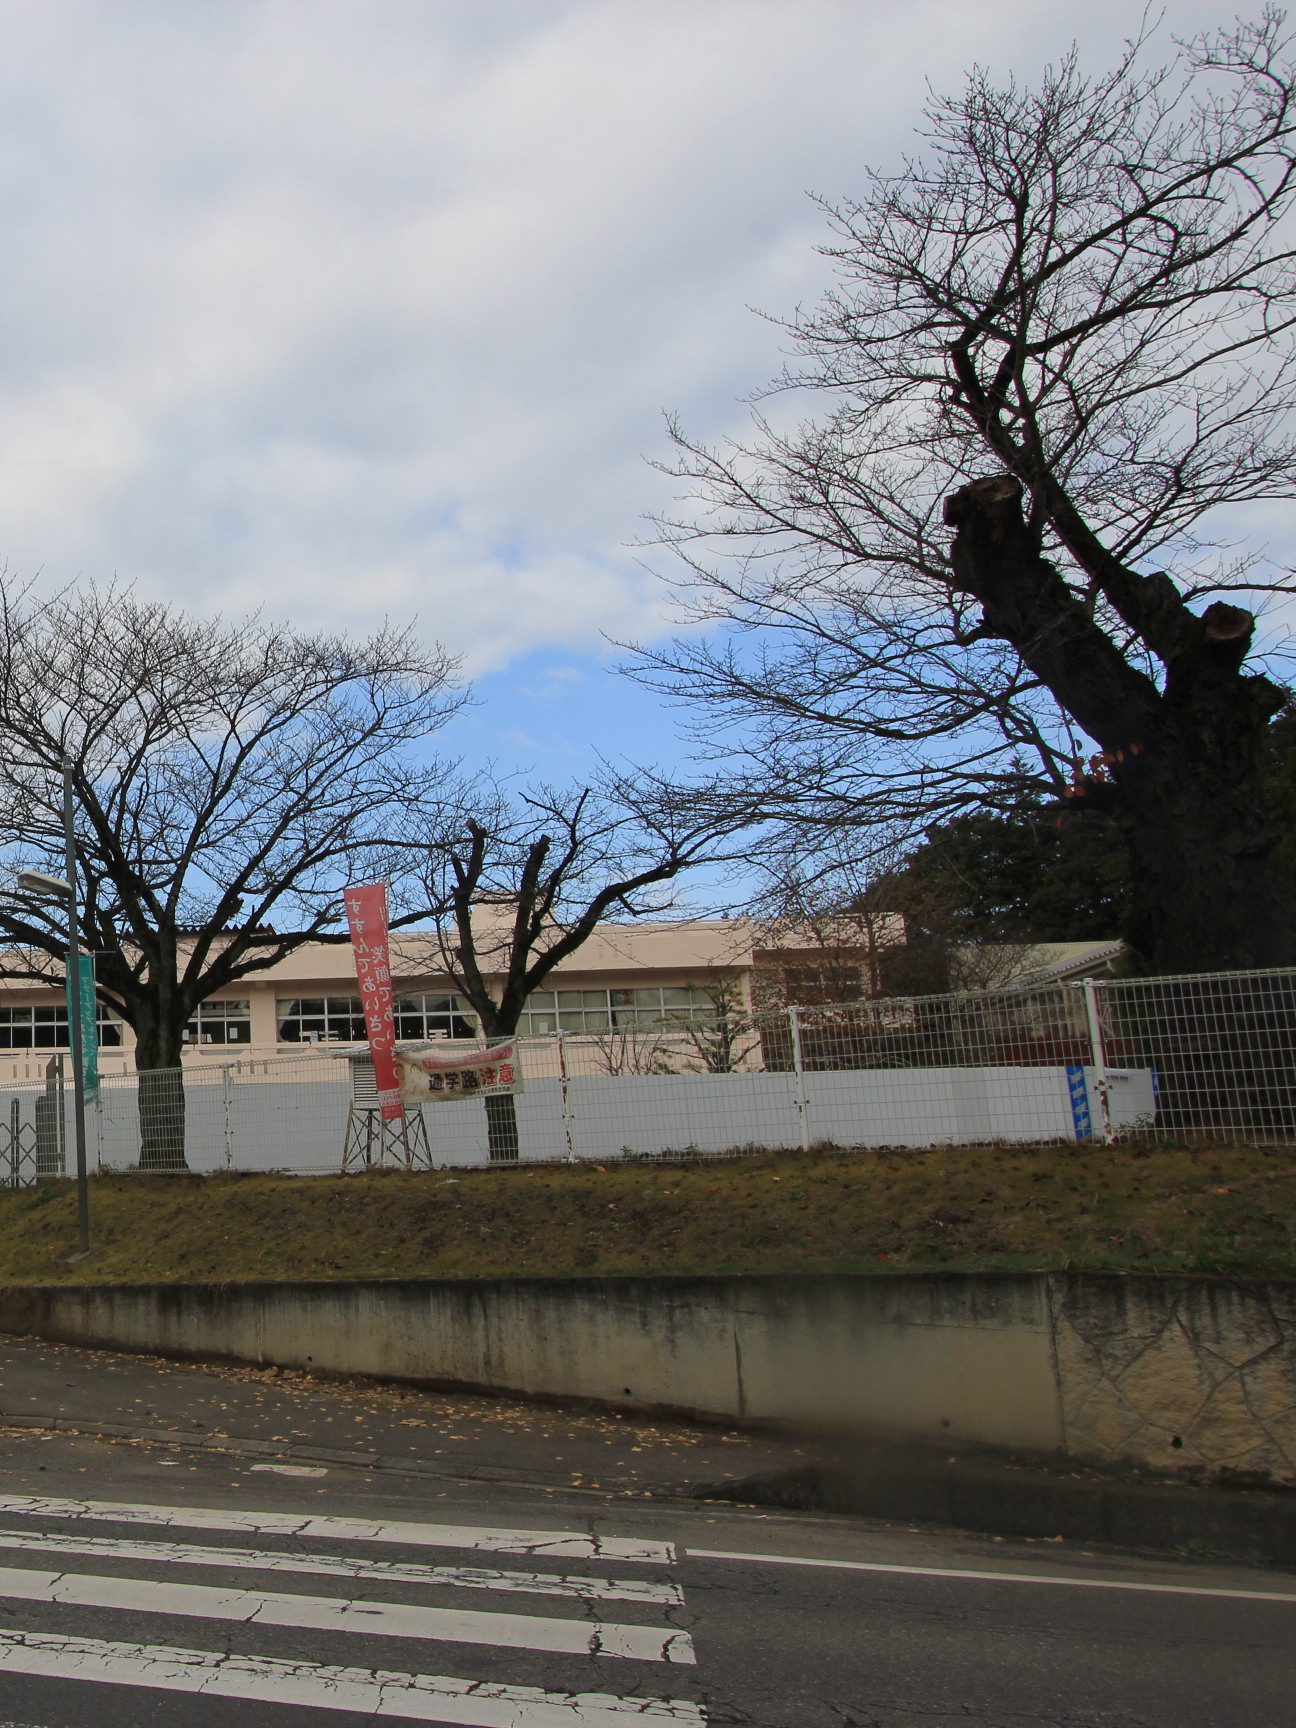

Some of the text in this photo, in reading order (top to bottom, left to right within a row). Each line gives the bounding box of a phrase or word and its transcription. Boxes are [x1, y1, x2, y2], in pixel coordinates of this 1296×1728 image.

[429, 1063, 515, 1093] 通学路注意
